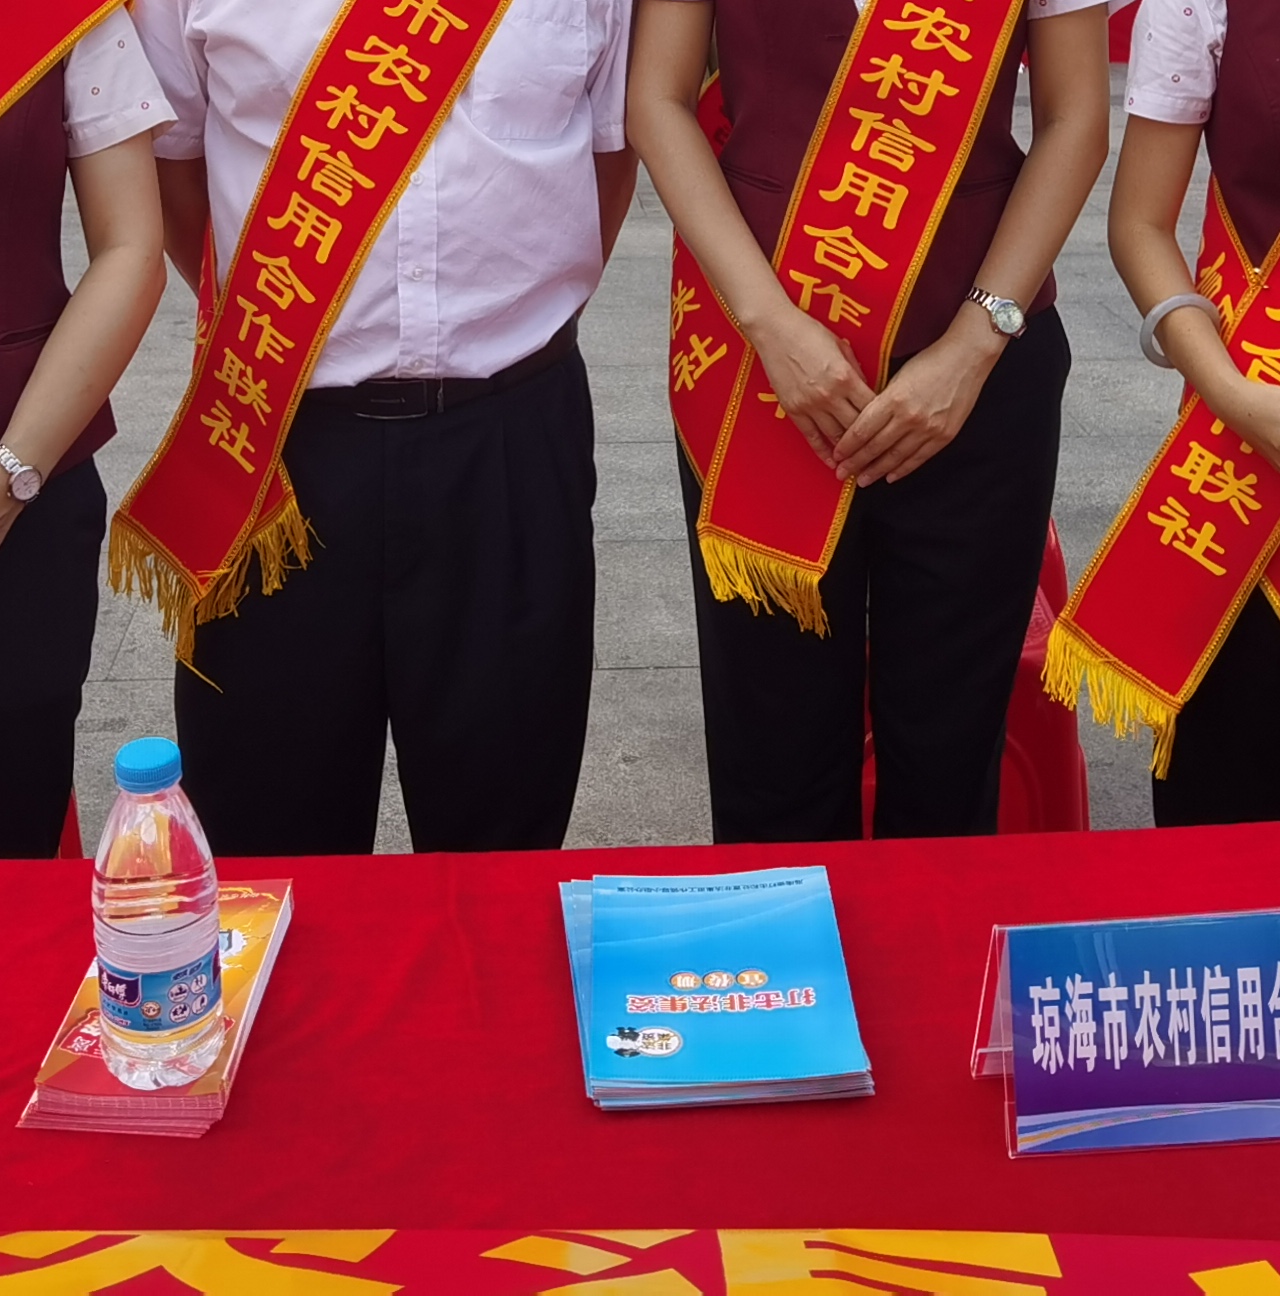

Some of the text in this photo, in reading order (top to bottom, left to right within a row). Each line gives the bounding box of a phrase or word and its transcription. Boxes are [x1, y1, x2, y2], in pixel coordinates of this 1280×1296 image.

[627, 987, 816, 1014] 打击非法集资
